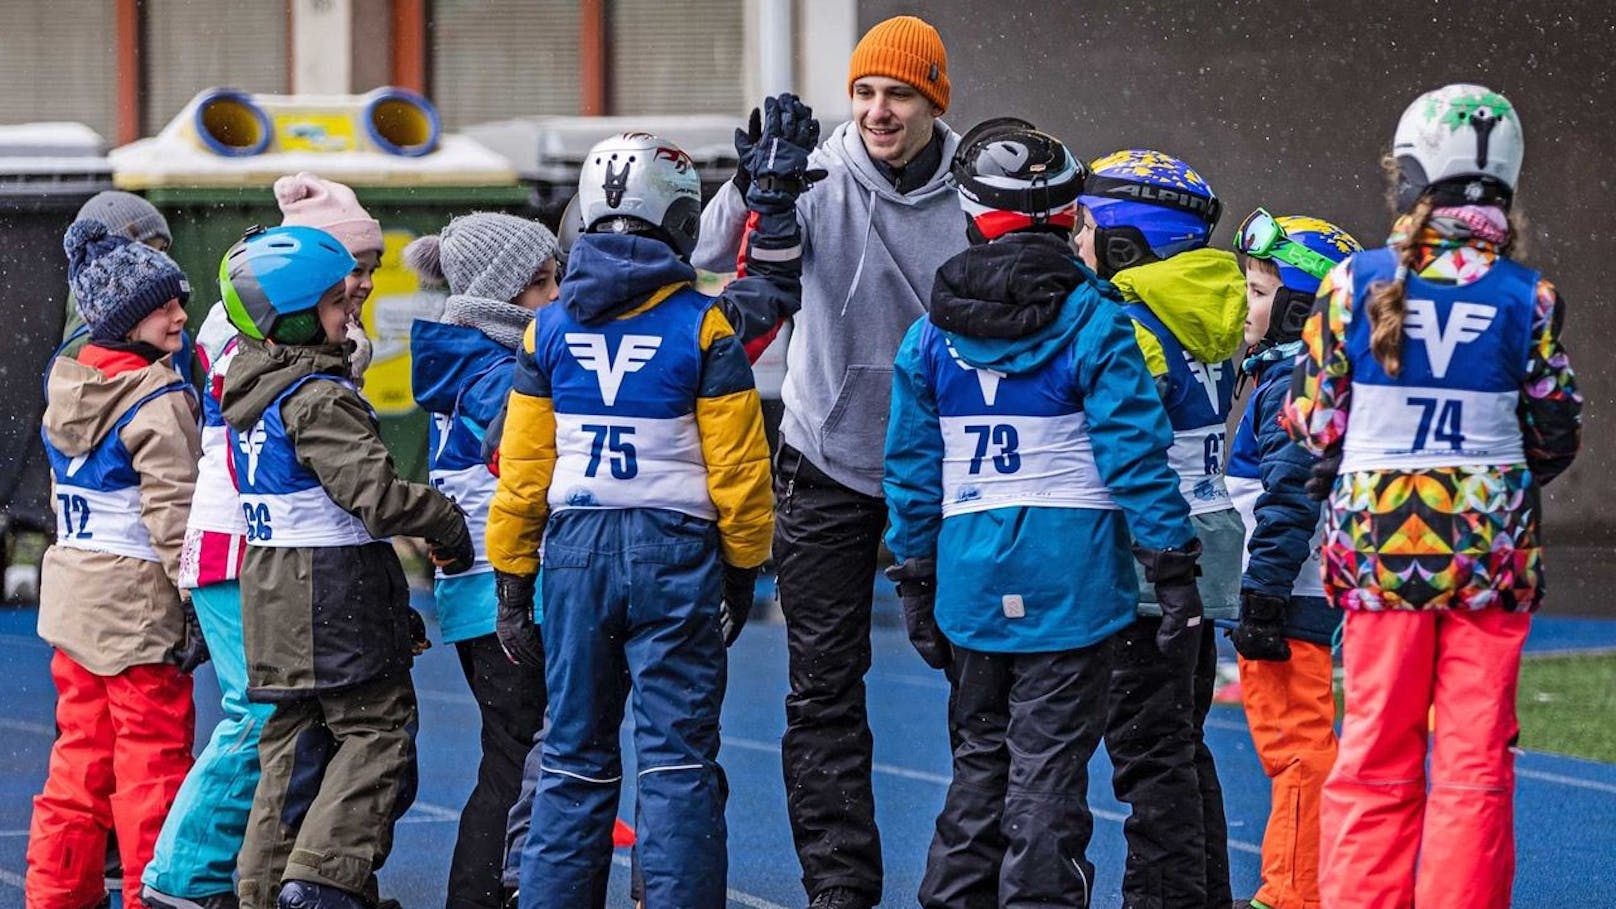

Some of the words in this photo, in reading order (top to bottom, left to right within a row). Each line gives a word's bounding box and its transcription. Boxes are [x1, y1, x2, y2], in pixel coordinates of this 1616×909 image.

[964, 423, 1021, 475] 73
[1406, 397, 1466, 453] 74
[581, 424, 638, 479] 75
[57, 494, 93, 539] 72
[243, 502, 272, 541] 66
